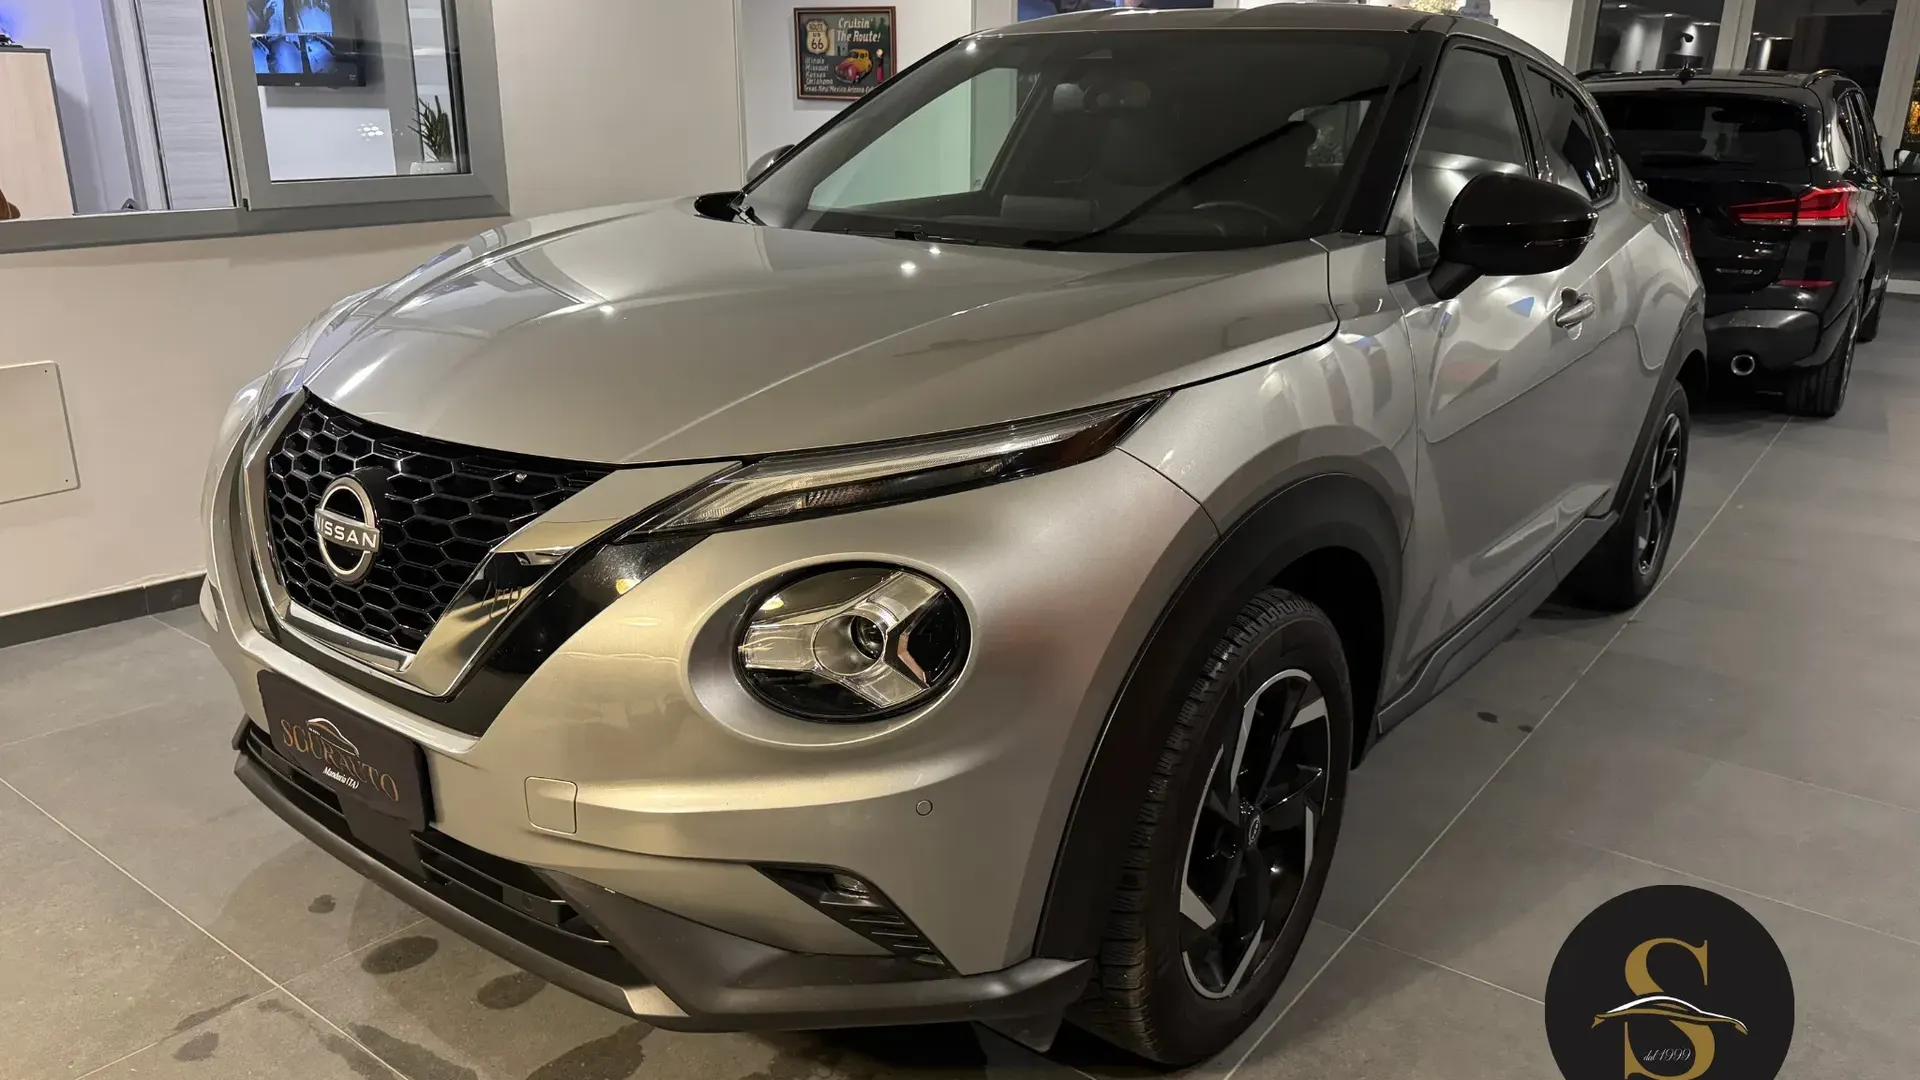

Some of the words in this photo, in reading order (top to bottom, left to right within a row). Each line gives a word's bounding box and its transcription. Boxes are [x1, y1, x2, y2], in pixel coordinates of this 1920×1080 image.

[838, 17, 873, 29] Cruisin'
[837, 30, 852, 42] The
[853, 30, 881, 43] Route!
[811, 38, 824, 50] 66
[315, 513, 377, 548] NISSAN
